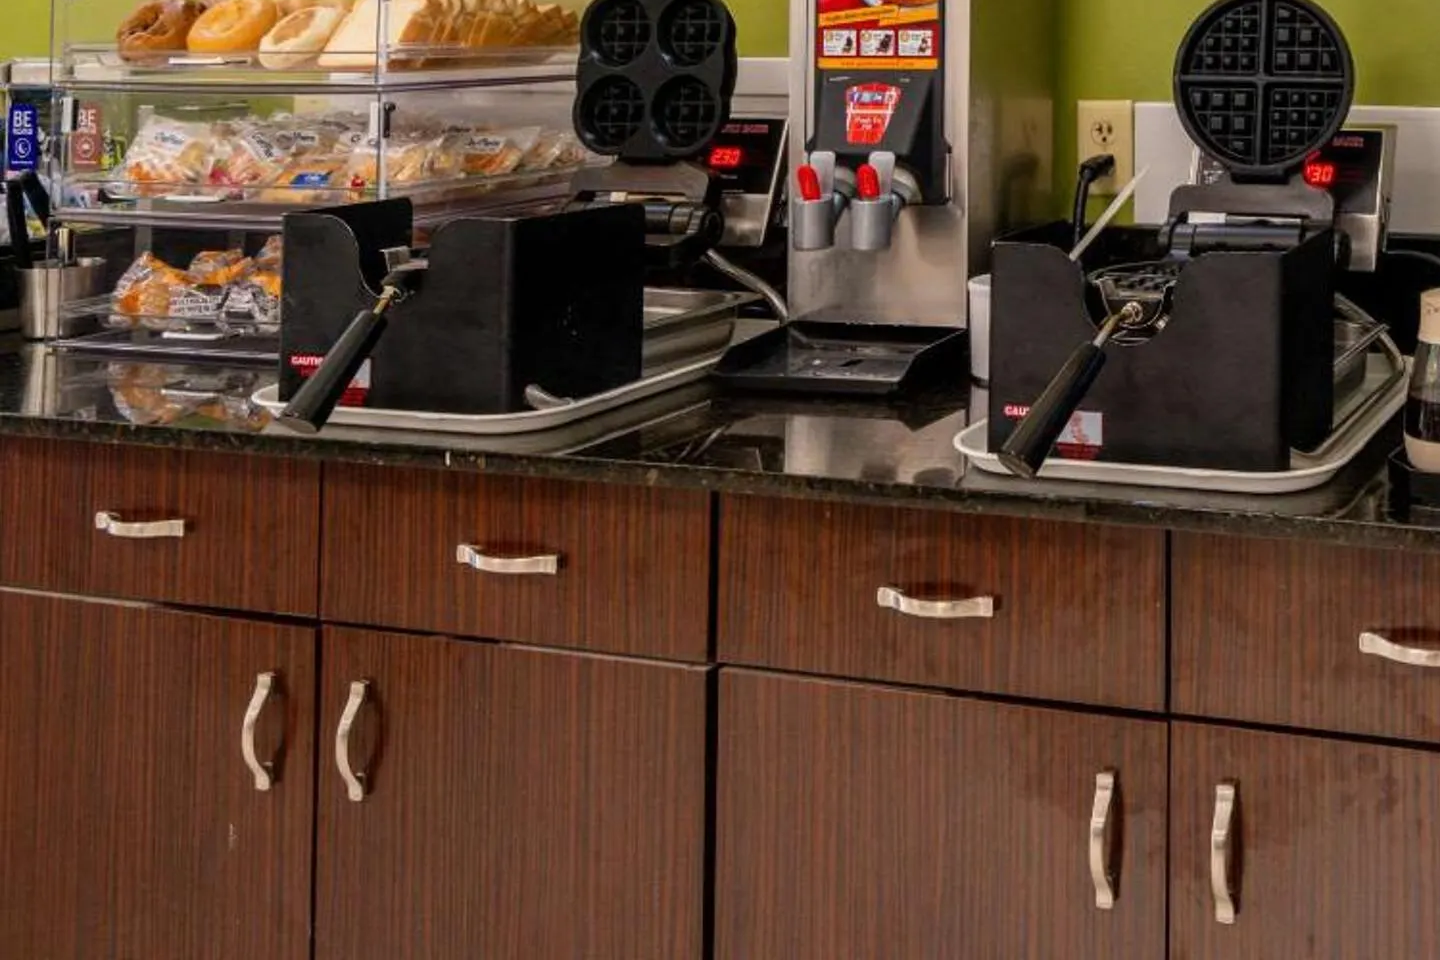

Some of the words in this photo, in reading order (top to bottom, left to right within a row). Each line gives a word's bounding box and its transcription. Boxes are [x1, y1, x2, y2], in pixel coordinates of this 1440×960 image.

[13, 110, 32, 128] BE
[710, 149, 741, 166] 230
[1004, 405, 1029, 416] CAU
